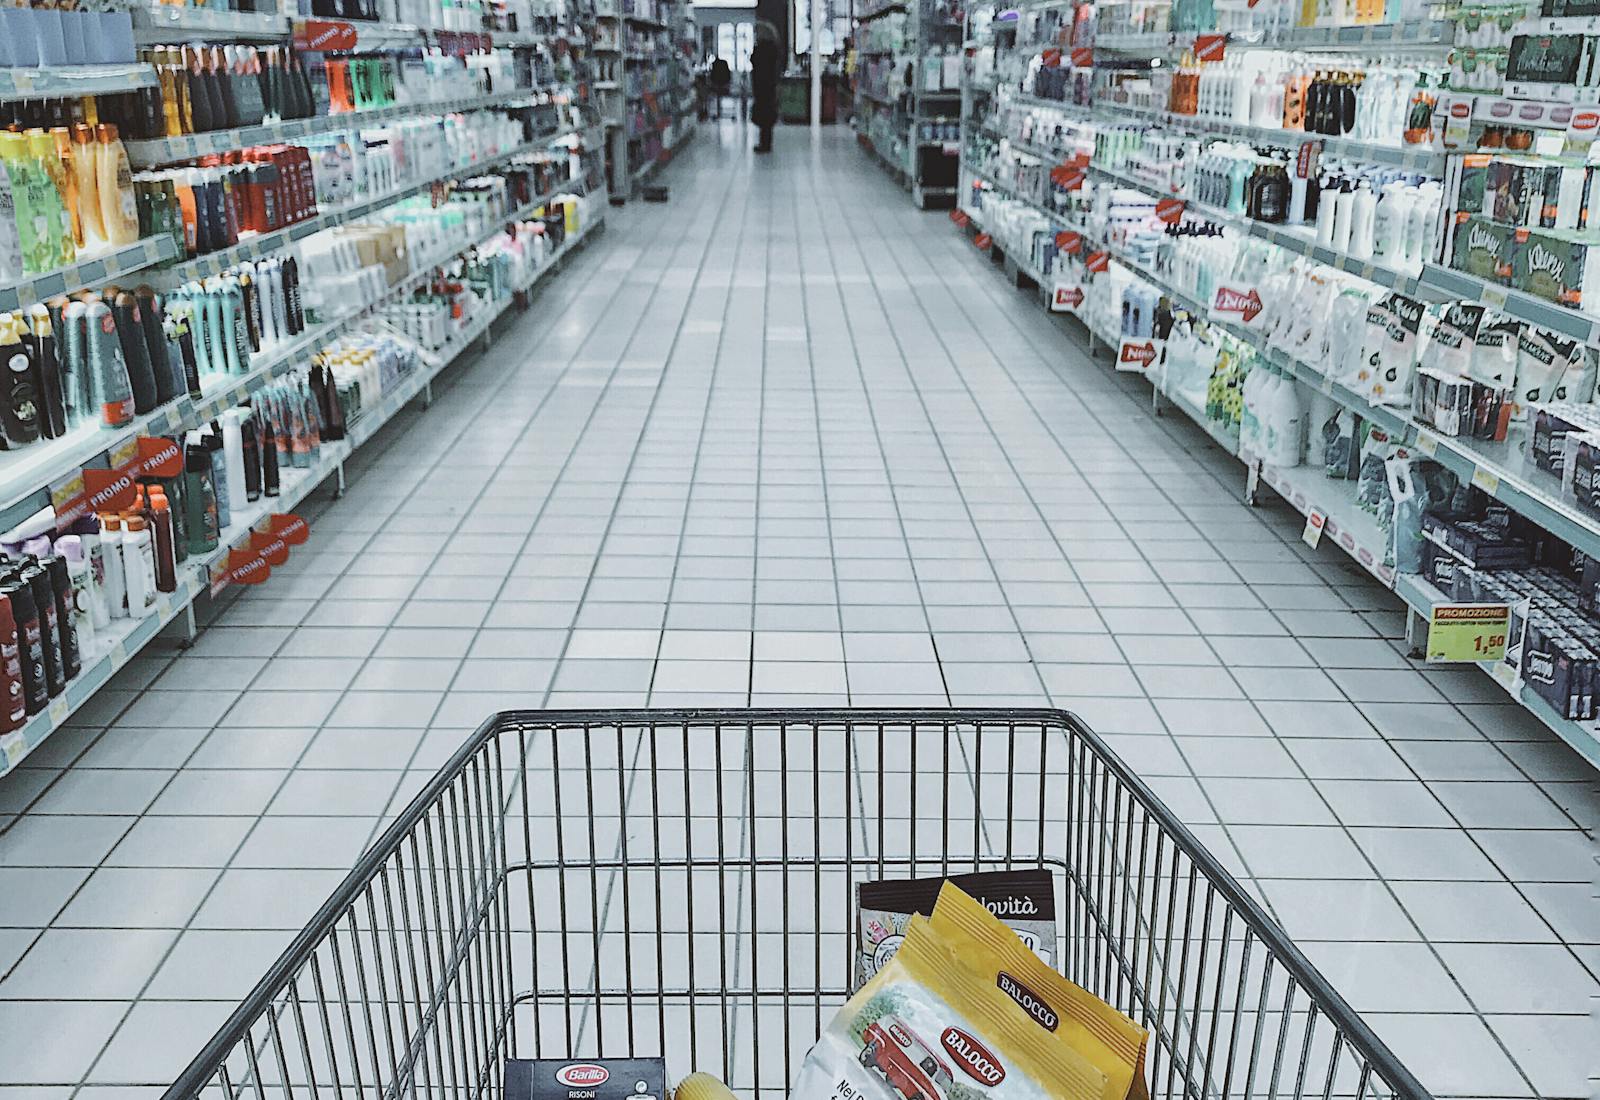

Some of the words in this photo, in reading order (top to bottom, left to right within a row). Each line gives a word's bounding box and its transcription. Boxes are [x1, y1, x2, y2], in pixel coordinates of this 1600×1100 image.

[143, 444, 179, 472] PROMO
[90, 476, 131, 508] PROMO
[231, 557, 266, 580] PROMO
[1437, 608, 1505, 618] PROMOZIONE
[1474, 635, 1505, 655] 1,50
[1000, 975, 1057, 1027] BALOCCO
[945, 1029, 1002, 1083] BALOCCO
[568, 1069, 604, 1080] Barilla
[568, 1090, 595, 1099] RISONI
[836, 1079, 857, 1100] Nel
